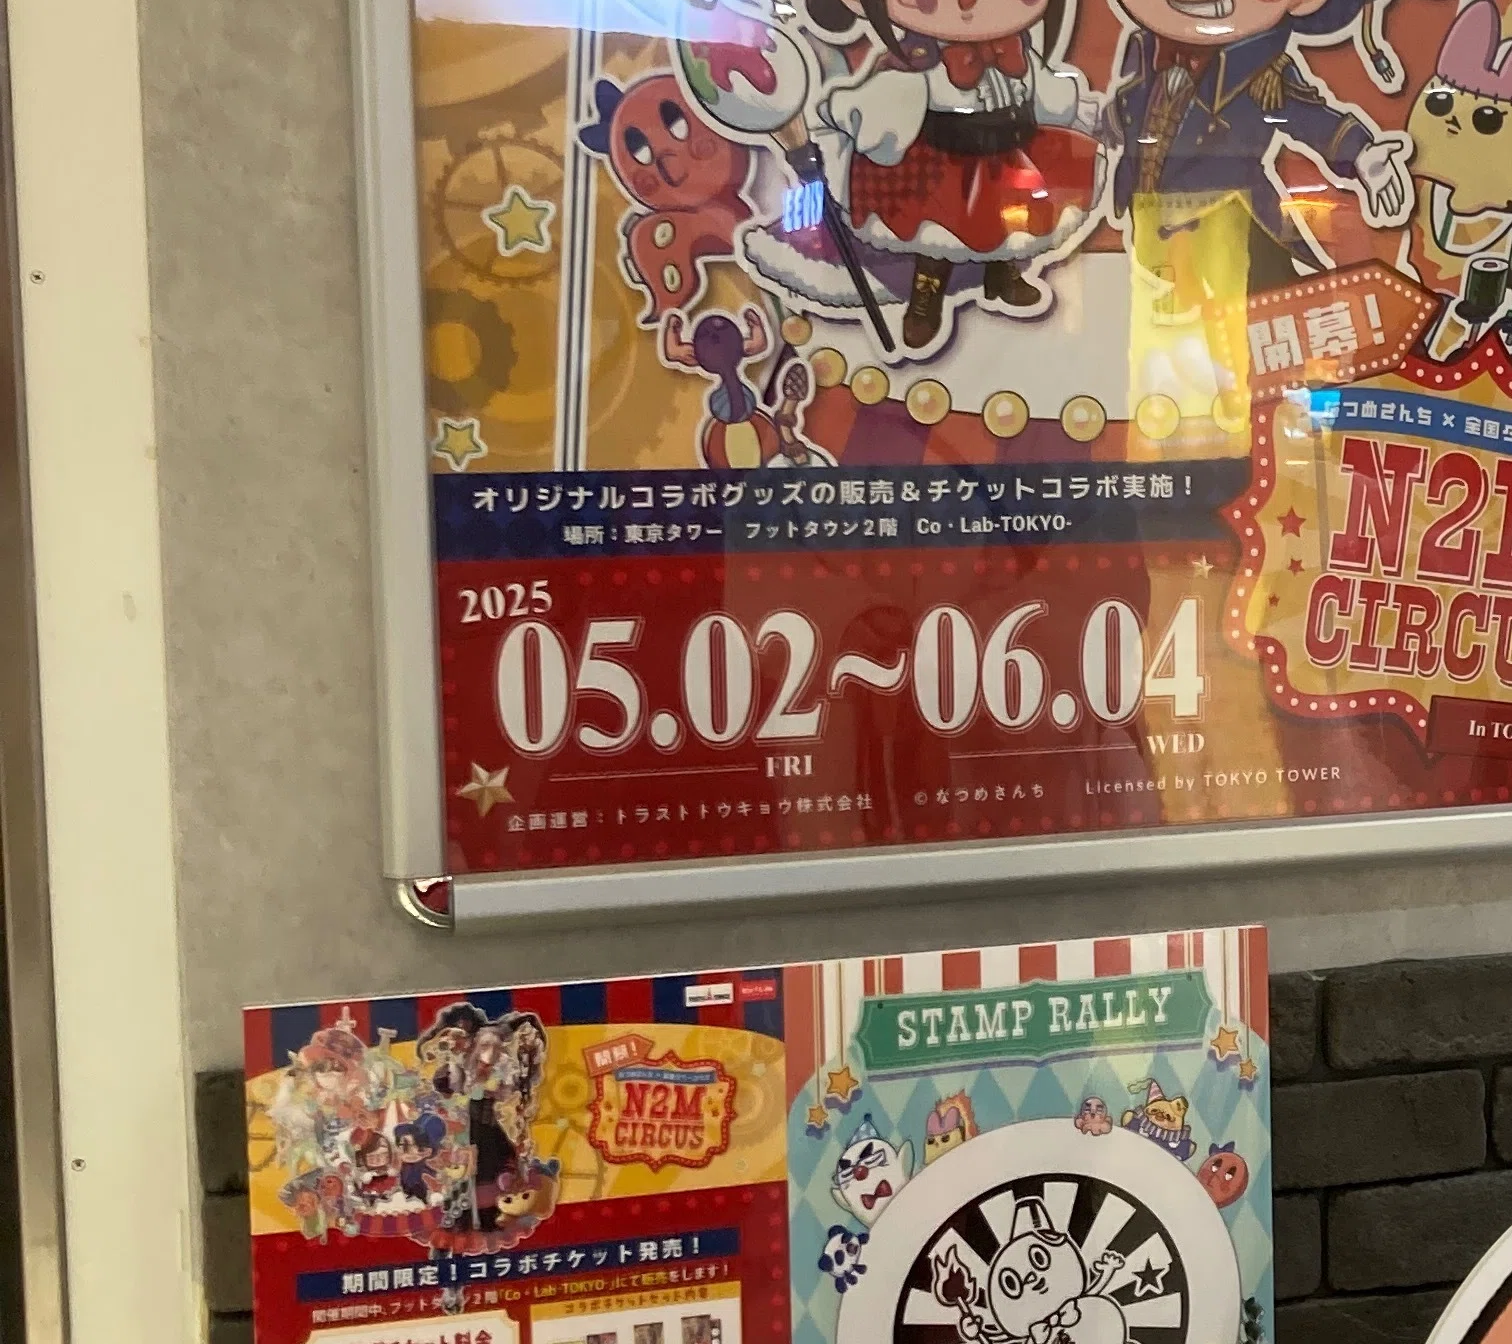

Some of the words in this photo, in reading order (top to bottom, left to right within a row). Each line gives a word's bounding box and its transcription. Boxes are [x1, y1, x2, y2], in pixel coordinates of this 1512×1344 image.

[458, 579, 553, 624] 2025
[1469, 719, 1487, 737] In
[1146, 732, 1206, 756] WED
[765, 754, 814, 778] FRI
[1085, 775, 1167, 796] Licensed
[1175, 774, 1196, 793] by
[1203, 769, 1267, 788] TOKYO
[1275, 765, 1341, 783] TOWER
[898, 999, 1033, 1047] STAMP
[1049, 986, 1172, 1033] RALLY
[621, 1082, 707, 1120] N2M
[615, 1121, 704, 1149] CIRCUS
